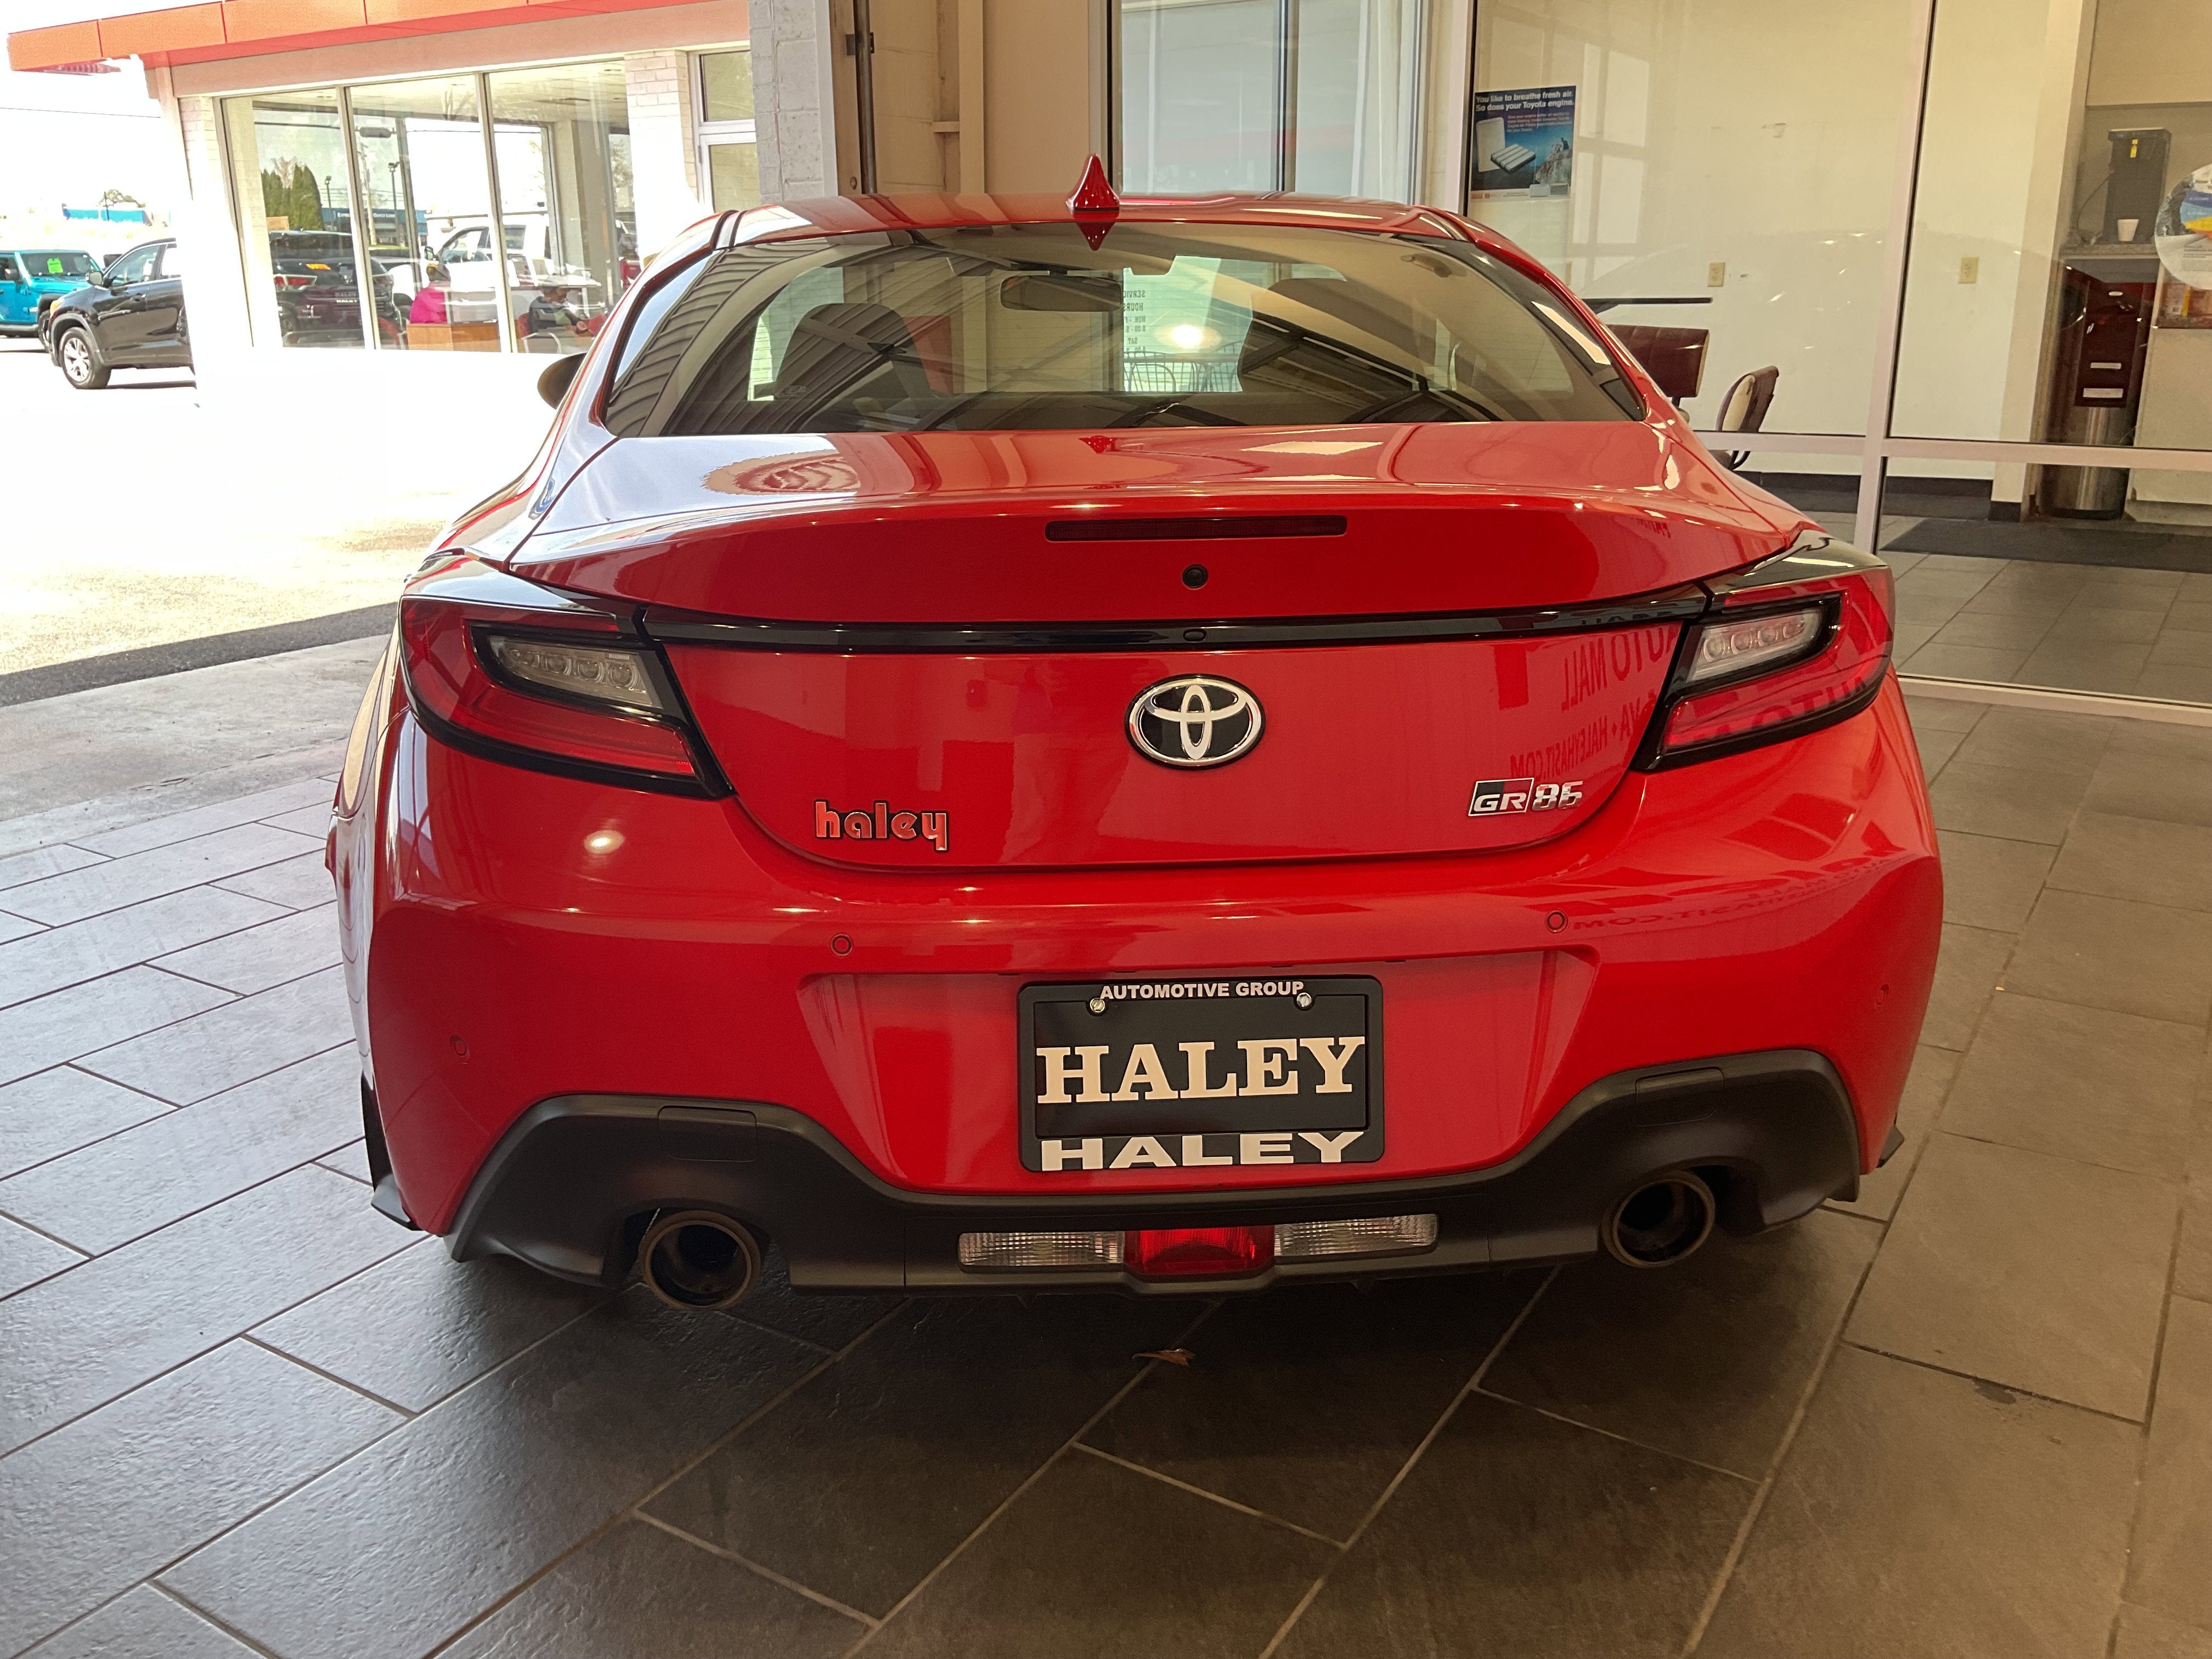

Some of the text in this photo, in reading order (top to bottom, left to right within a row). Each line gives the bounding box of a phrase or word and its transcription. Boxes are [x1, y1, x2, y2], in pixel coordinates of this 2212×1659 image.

[1505, 103, 1522, 111] your
[1523, 101, 1546, 110] Toyota
[1547, 99, 1574, 108] engine.
[1513, 93, 1541, 101] breathe
[1542, 91, 1561, 99] fresh
[1474, 781, 1583, 812] GR 86
[815, 800, 948, 851] haley
[1099, 981, 1305, 1000] AUTOMOTIVE GROUP
[1036, 1036, 1365, 1104] HALEY
[1041, 1131, 1364, 1171] HALEY
